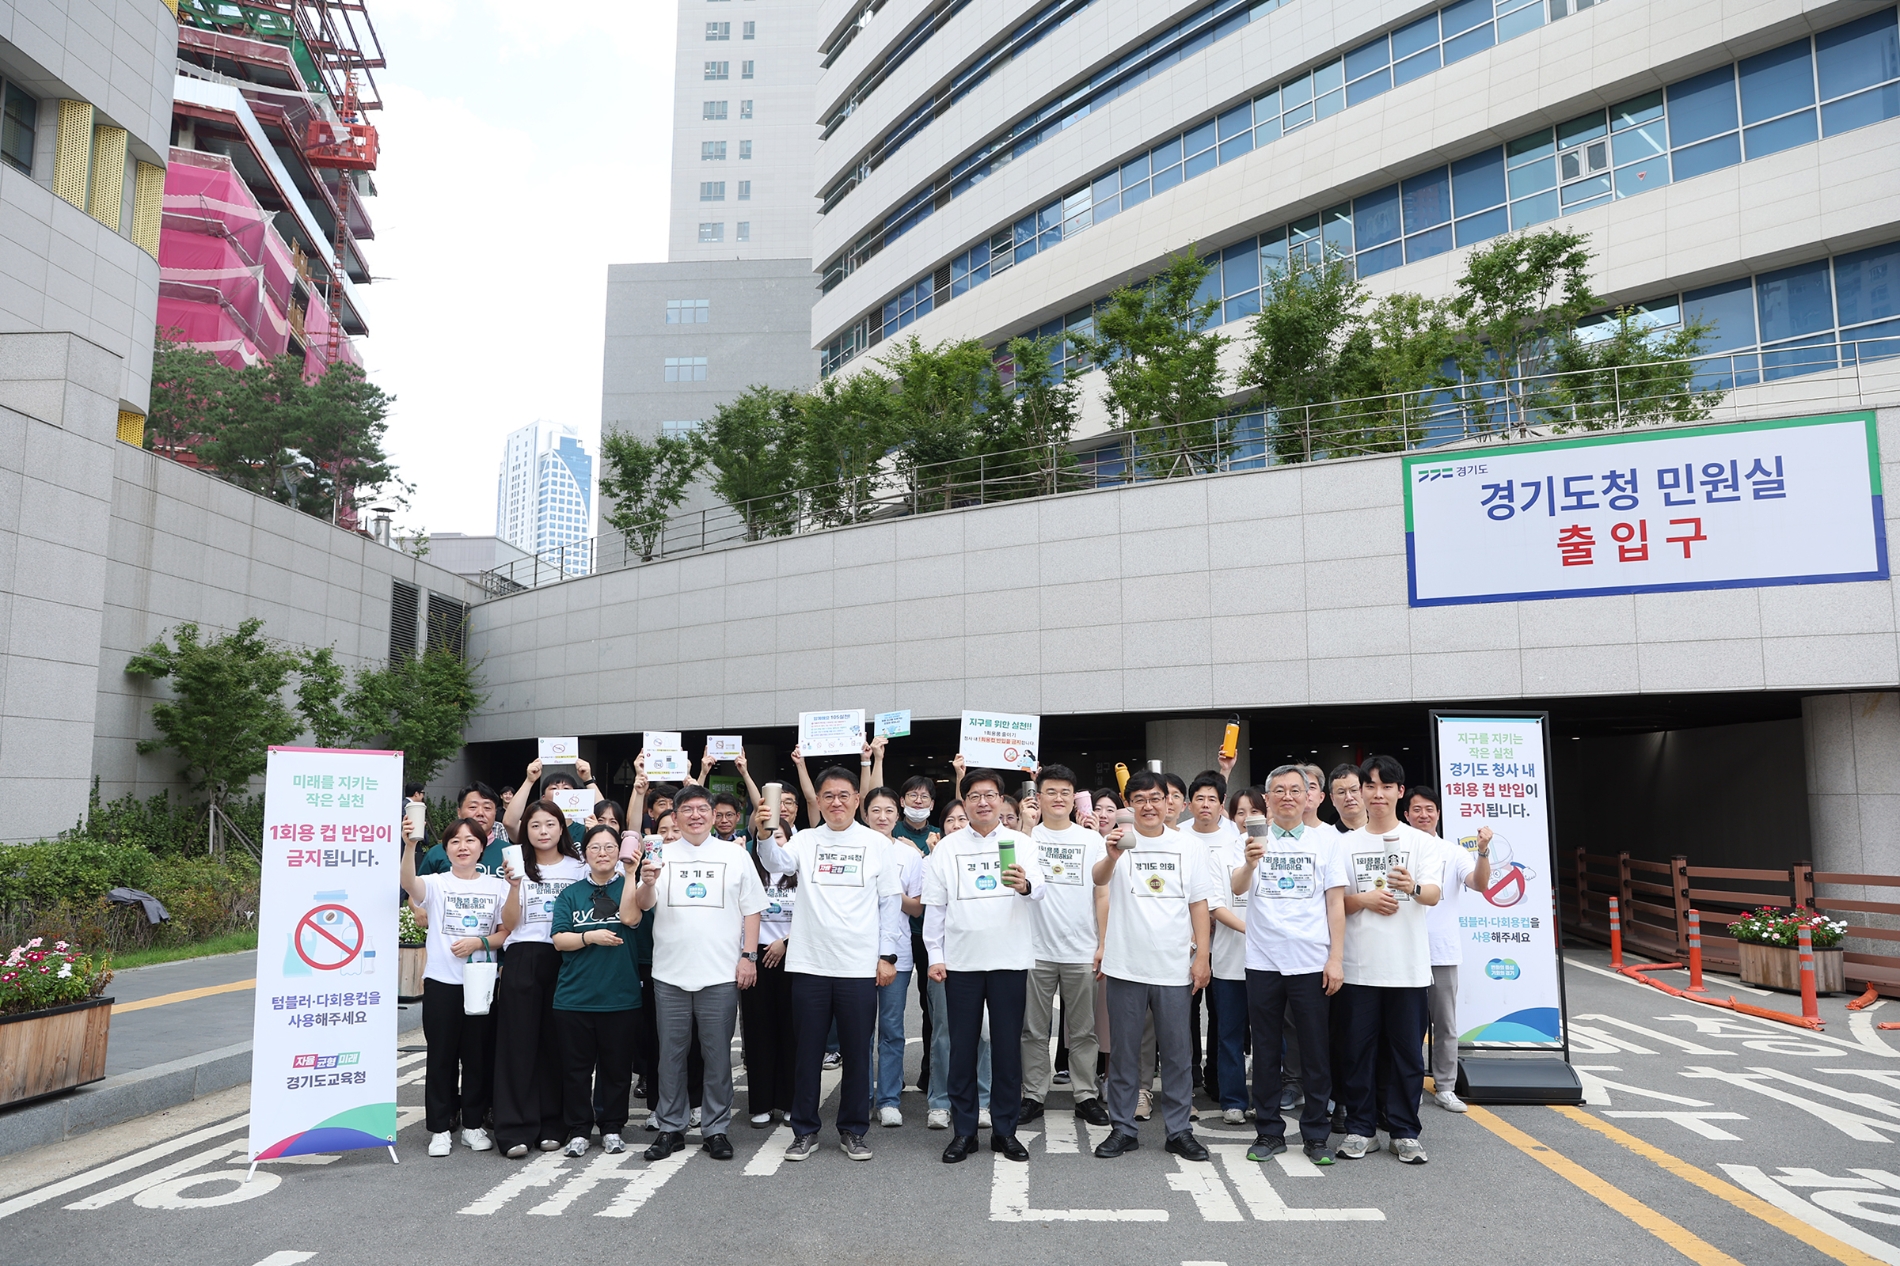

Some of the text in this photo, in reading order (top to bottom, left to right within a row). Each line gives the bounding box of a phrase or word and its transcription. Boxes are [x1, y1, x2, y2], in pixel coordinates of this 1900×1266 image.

[1456, 464, 1488, 477] 경기도
[1480, 455, 1787, 521] 경기도청 민원실
[969, 718, 1032, 730] 지구를 위한 실천!!
[1458, 732, 1523, 744] 지구를 지키는
[1469, 747, 1514, 759] 작은 실천
[1450, 762, 1535, 778] 경기도 청사 내
[293, 774, 378, 790] 미래를 지키는
[1446, 782, 1538, 798] 1회용 컵 반입이
[306, 792, 364, 808] 작은 실천
[1460, 803, 1530, 818] 금지됩니다.
[270, 824, 392, 842] 1회용 컵 반입이
[286, 849, 380, 867] 금지됩니다.
[1135, 862, 1175, 870] 경기도 의회
[1458, 916, 1540, 928] 텀블러·다회용컵을
[1472, 932, 1531, 943] 사용해주세요
[272, 991, 381, 1010] 텀블러·다회용컵을
[288, 1010, 368, 1028] 사용해주세요
[294, 1053, 358, 1068] 자율 균형 미래
[286, 1070, 366, 1090] 경기도교육청
